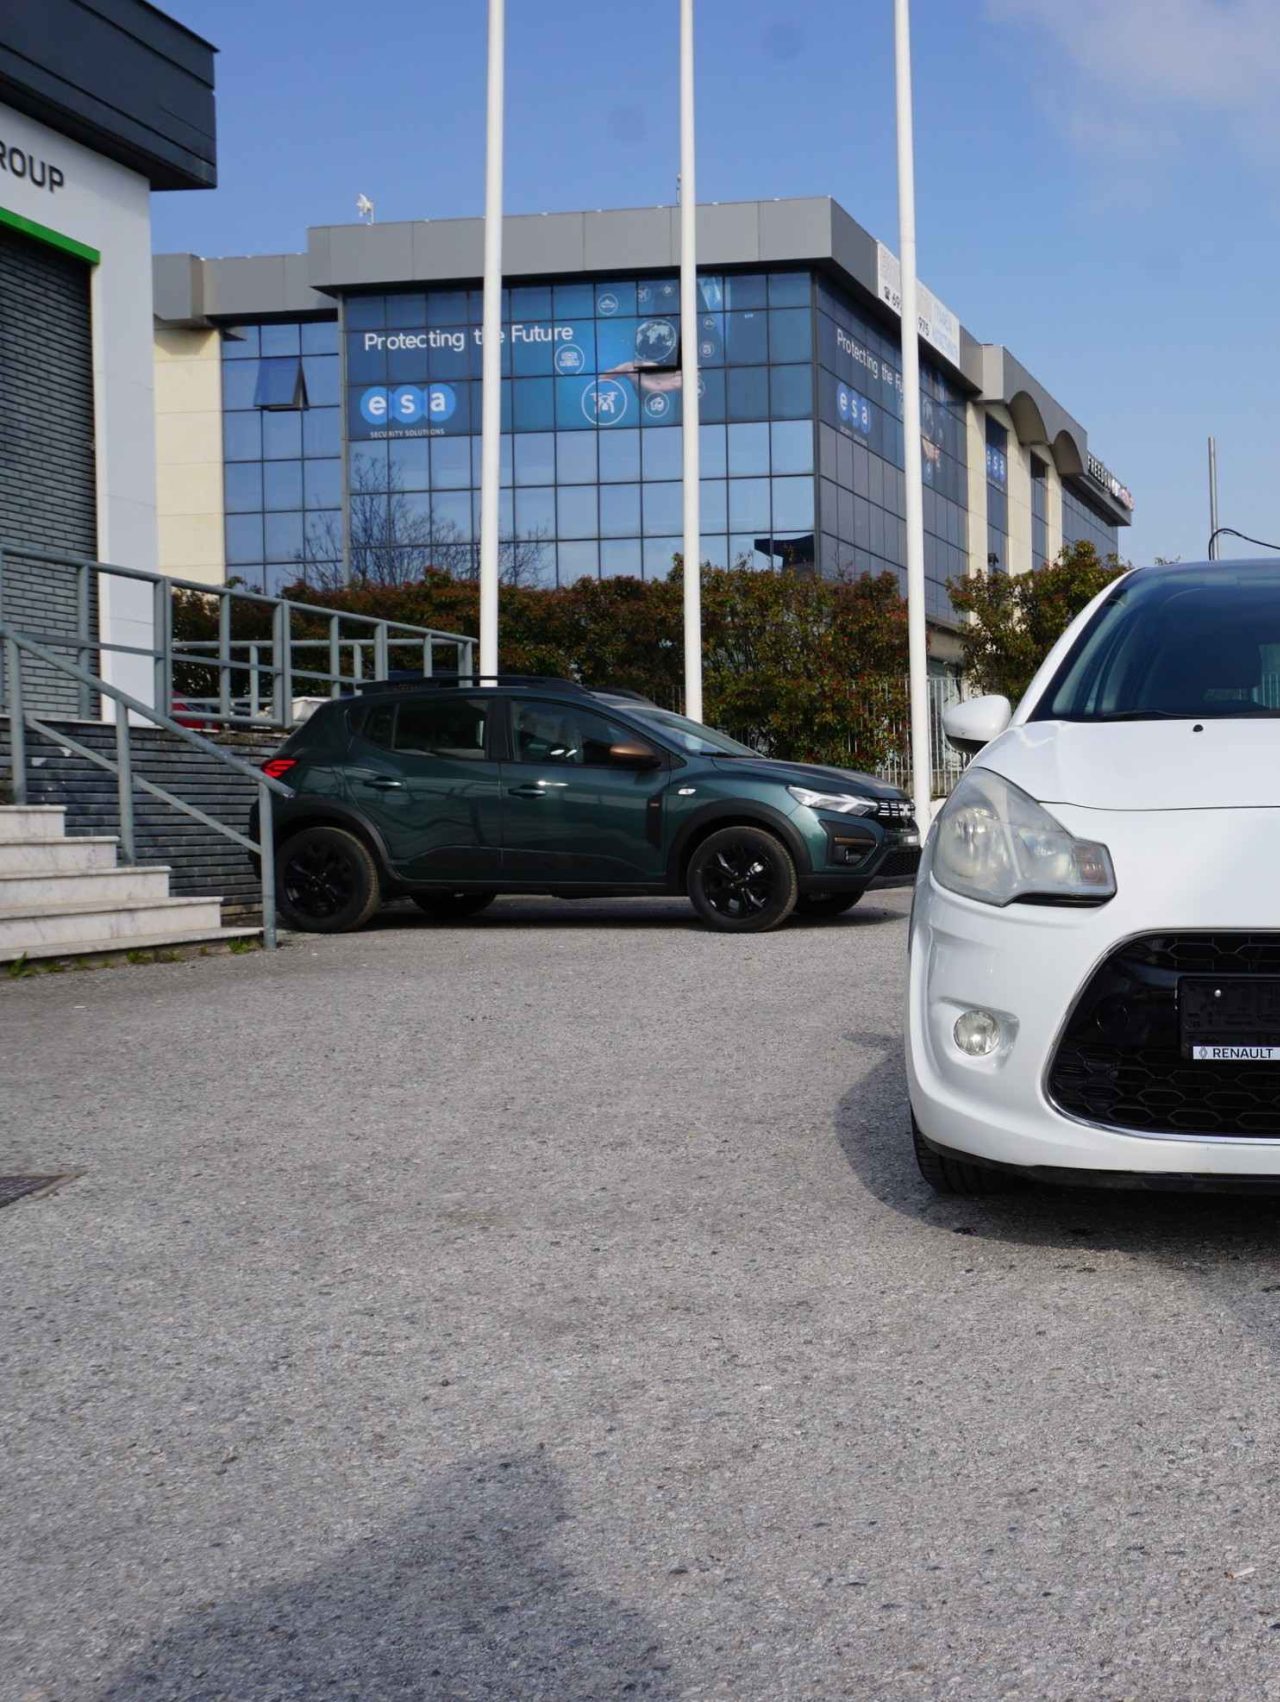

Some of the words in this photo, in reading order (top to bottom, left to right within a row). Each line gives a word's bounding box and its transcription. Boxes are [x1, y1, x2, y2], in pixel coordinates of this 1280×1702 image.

[364, 329, 465, 352] Protecting
[511, 324, 573, 343] Future
[837, 328, 878, 379] Protecting
[882, 363, 893, 385] the
[368, 391, 446, 416] esa
[840, 392, 868, 425] esa
[370, 430, 403, 439] SECURITY
[405, 427, 446, 437] SOLUTIONS
[1212, 1047, 1273, 1059] RENAULT
